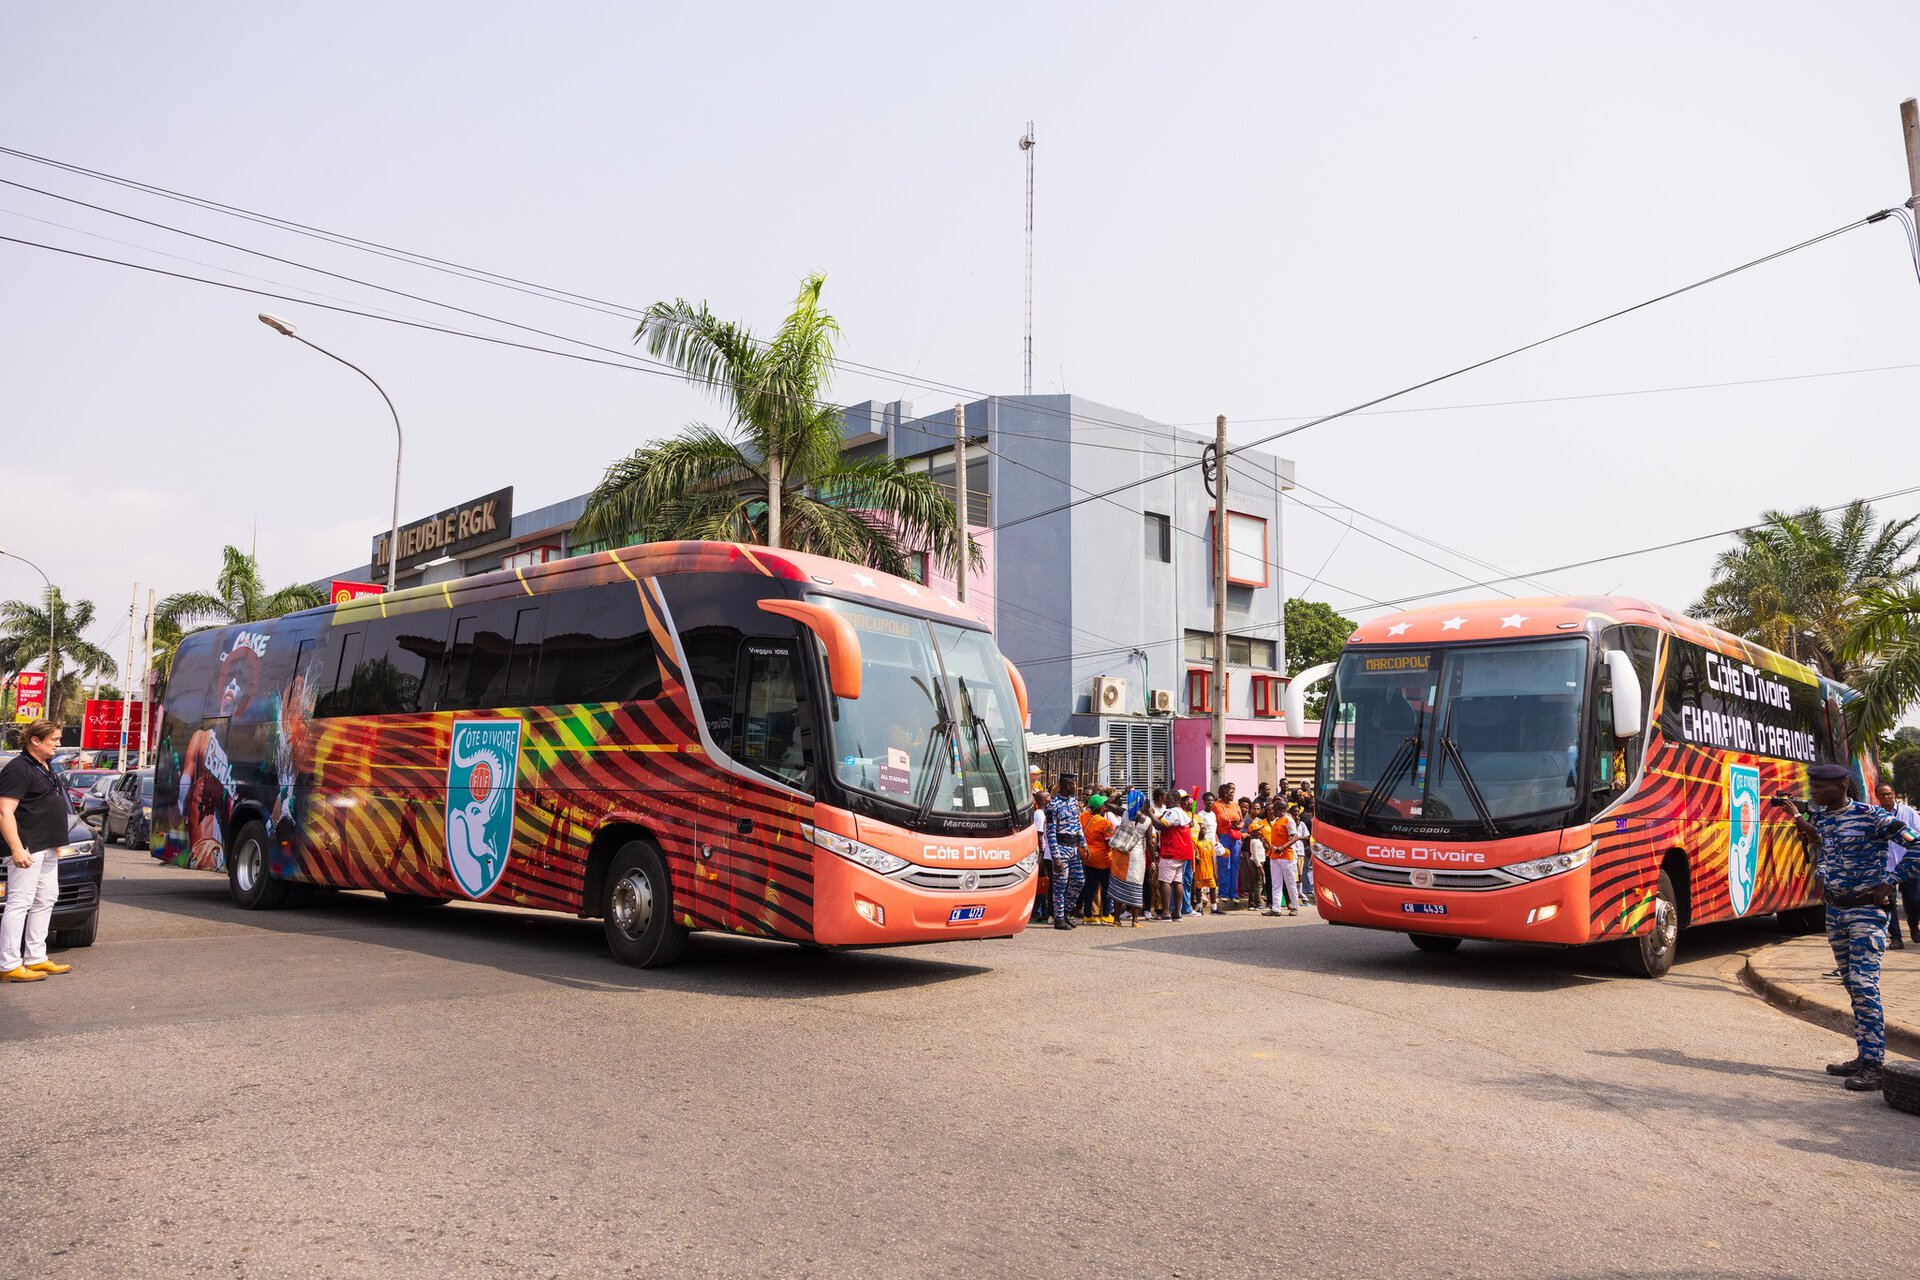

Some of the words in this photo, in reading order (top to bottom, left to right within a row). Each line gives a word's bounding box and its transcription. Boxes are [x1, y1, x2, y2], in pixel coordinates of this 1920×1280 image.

[459, 501, 497, 540] RGK
[1705, 651, 1742, 697] Côte
[1682, 705, 1756, 752] CHAMPION
[943, 820, 987, 829] Marcopolo
[1391, 825, 1450, 834] Marcopolo
[923, 845, 960, 860] Côte
[1366, 845, 1406, 858] Côte
[1404, 903, 1414, 912] CH
[1423, 904, 1444, 914] 4439
